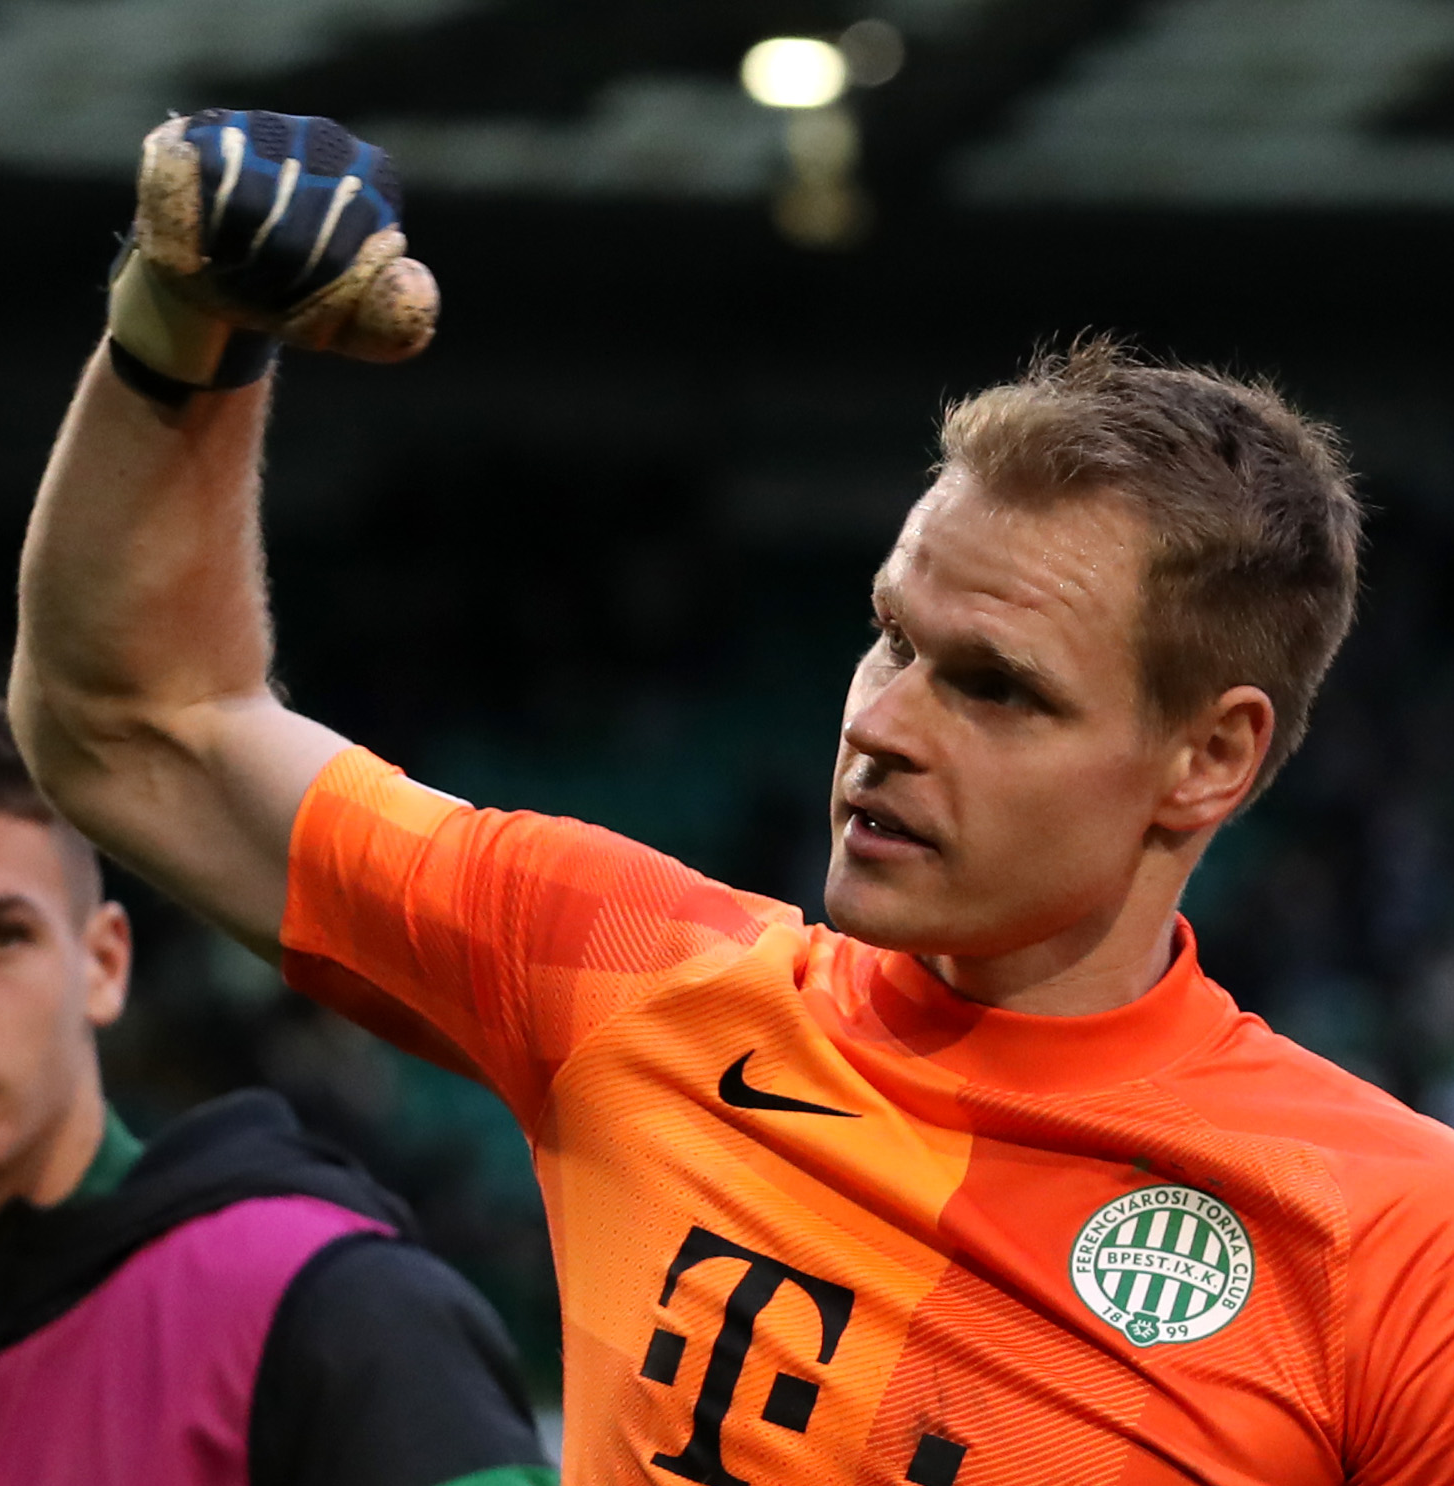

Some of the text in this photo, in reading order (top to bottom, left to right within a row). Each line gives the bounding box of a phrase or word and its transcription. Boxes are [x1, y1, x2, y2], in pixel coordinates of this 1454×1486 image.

[1077, 1190, 1248, 1310] FERENCVÁROSI TORNA CLUB
[1101, 1305, 1189, 1339] 18 99
